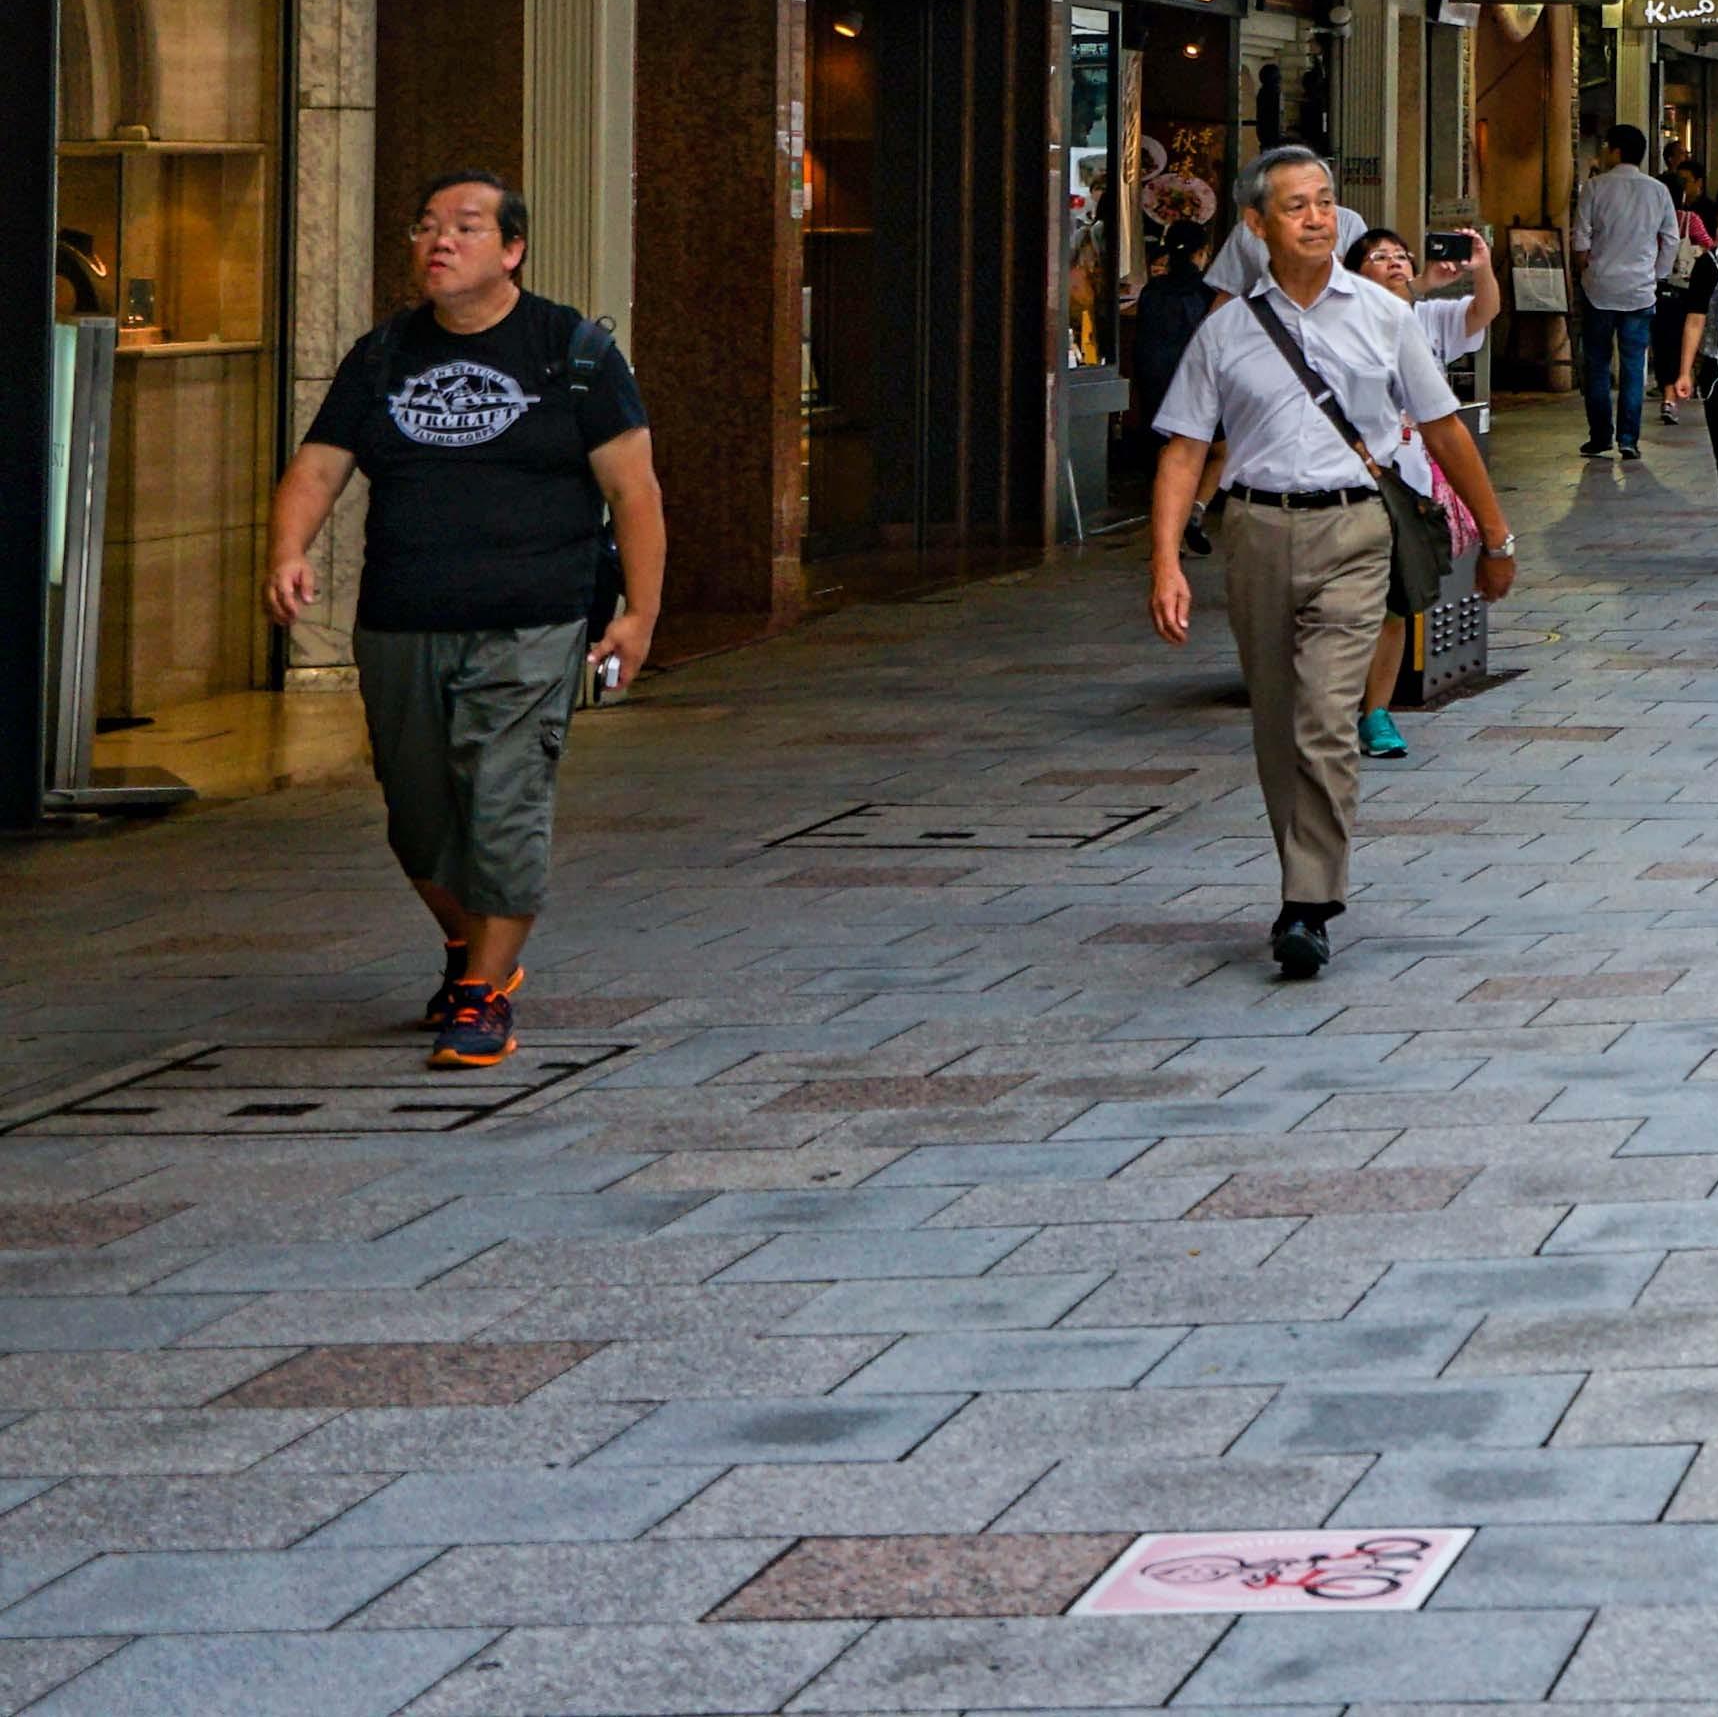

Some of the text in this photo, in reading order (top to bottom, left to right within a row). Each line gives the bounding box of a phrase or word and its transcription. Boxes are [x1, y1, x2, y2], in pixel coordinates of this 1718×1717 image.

[400, 404, 517, 426] AIRCRAFT
[413, 427, 496, 443] FLYING CORPS
